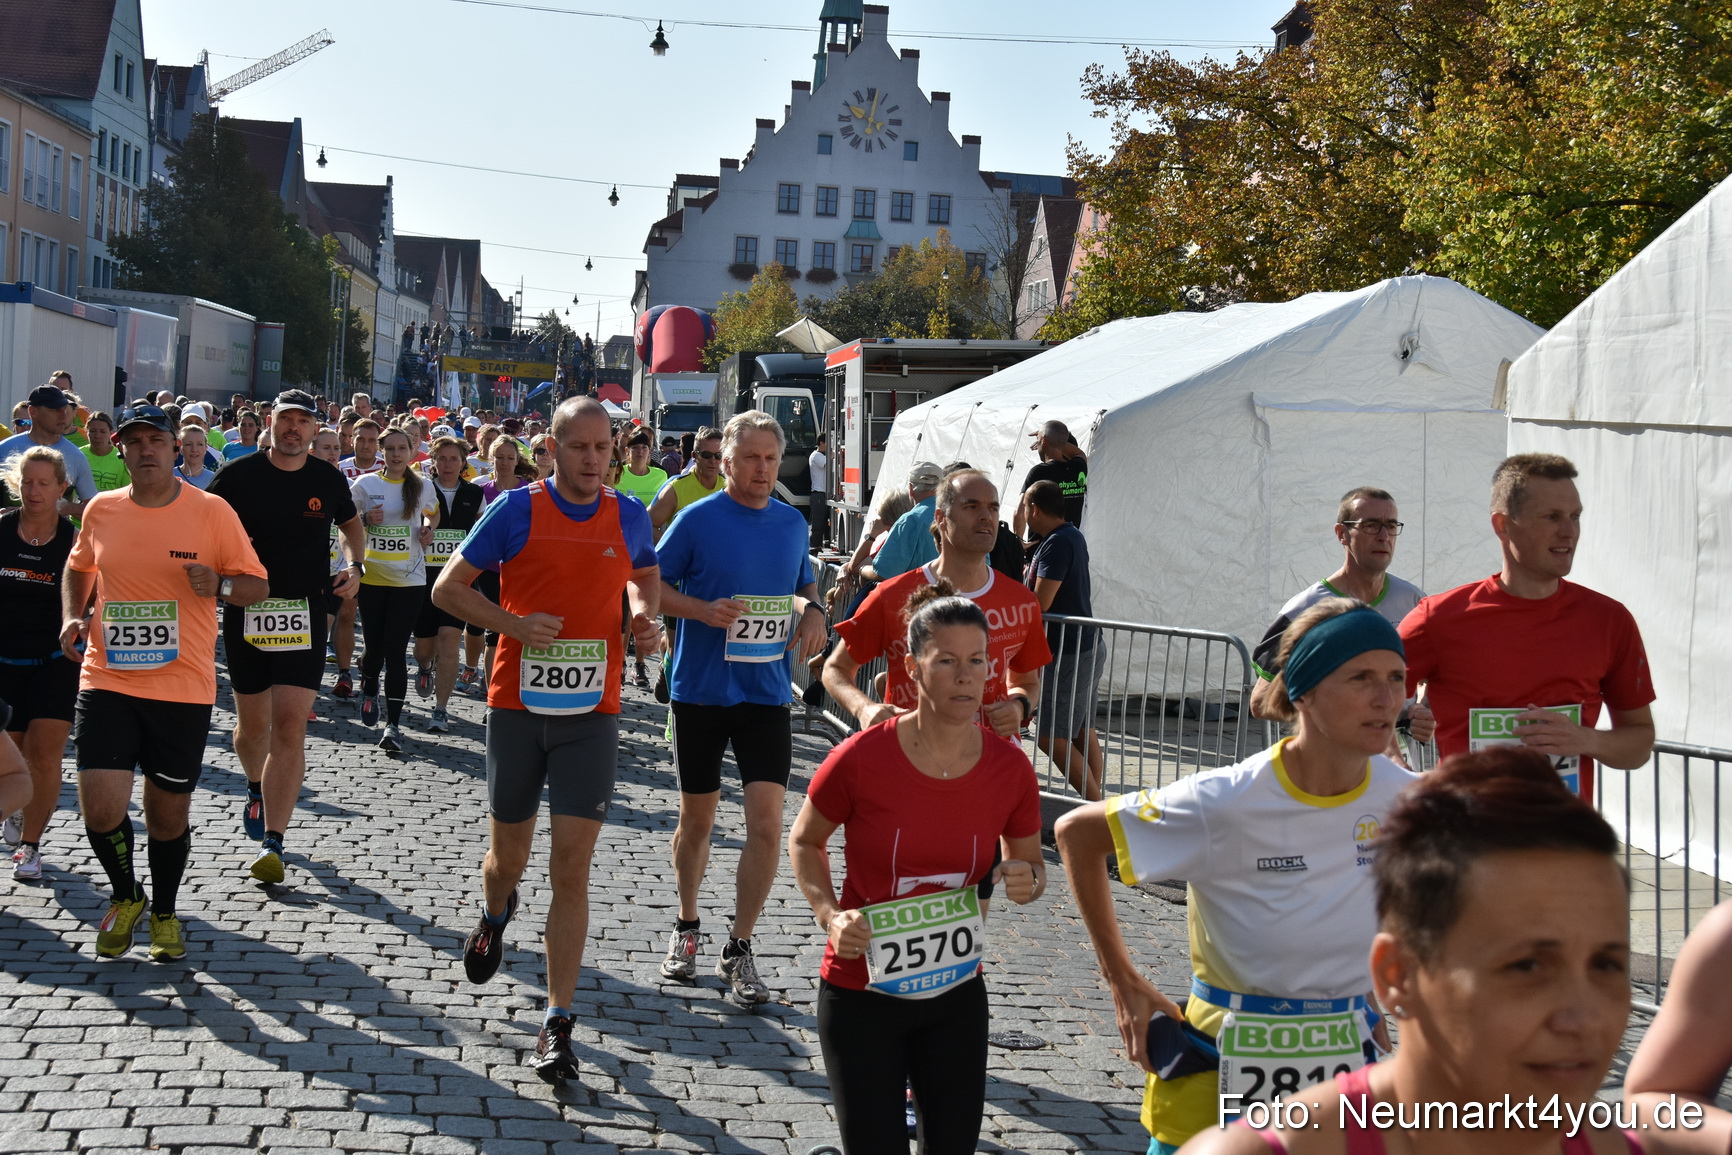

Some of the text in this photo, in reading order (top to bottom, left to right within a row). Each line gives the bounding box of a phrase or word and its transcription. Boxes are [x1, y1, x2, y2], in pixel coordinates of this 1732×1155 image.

[262, 359, 281, 372] BO
[479, 361, 518, 374] START
[1061, 486, 1086, 495] eumarkt
[370, 525, 408, 537] BOCK
[370, 537, 406, 552] 1396
[169, 550, 198, 560] THULE
[106, 603, 171, 620] BOCK
[250, 600, 304, 611] BOCK
[253, 614, 303, 632] 1036
[736, 618, 786, 640] 2791
[109, 625, 170, 647] 2539
[251, 636, 303, 645] MATTHIAS
[988, 632, 1016, 645] henken
[114, 652, 164, 662] MARCOS
[528, 642, 600, 660] BOCK
[530, 664, 597, 689] 2807
[1257, 855, 1307, 870] BOCK
[868, 892, 975, 934] BOCK
[880, 926, 973, 975] 2570
[898, 969, 957, 993] STEFFI
[1234, 1018, 1356, 1054] BOCK
